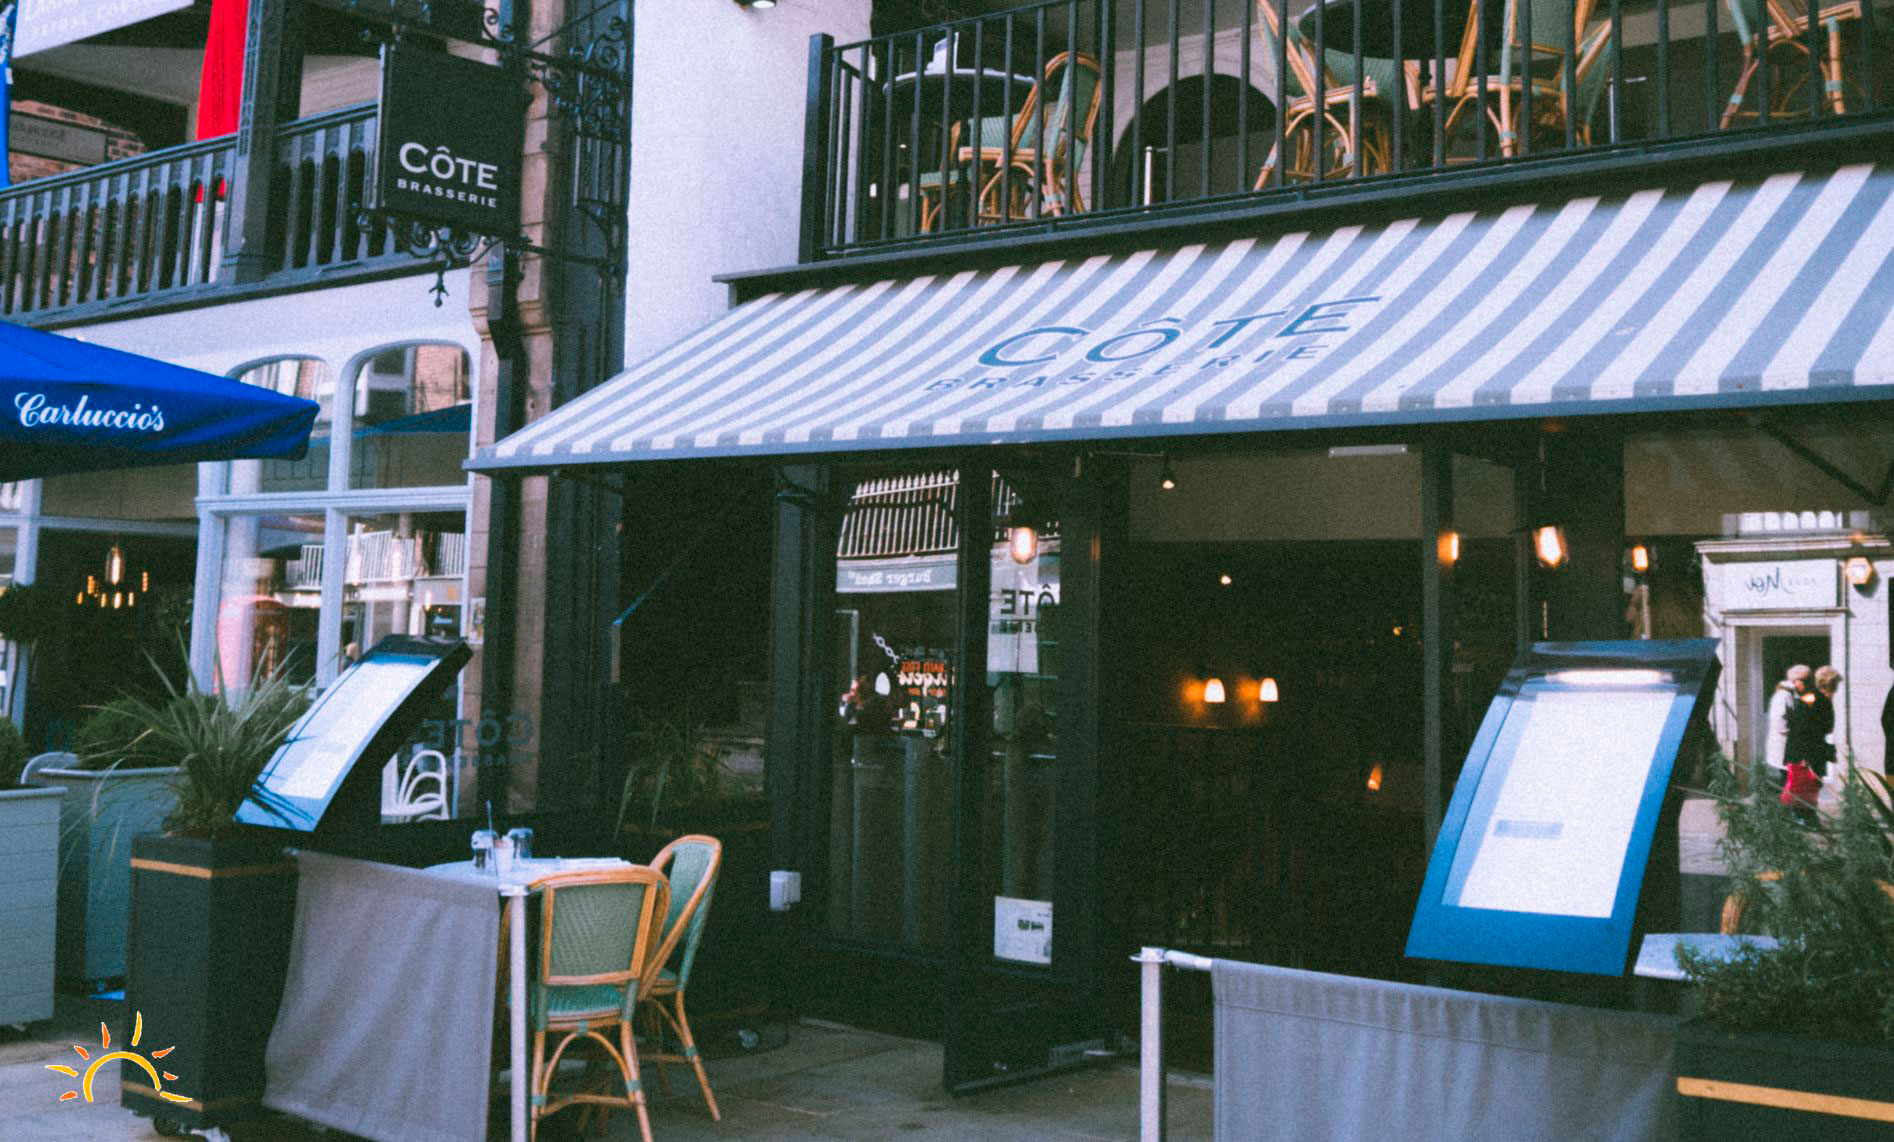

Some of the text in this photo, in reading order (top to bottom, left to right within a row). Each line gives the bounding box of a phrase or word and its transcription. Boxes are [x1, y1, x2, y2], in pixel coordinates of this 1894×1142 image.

[399, 142, 498, 190] CÔTE
[397, 178, 497, 208] BRASSERIE
[978, 296, 1382, 367] CÔTE
[924, 344, 1329, 391] BRASSERIE
[14, 392, 165, 431] Carluccio's
